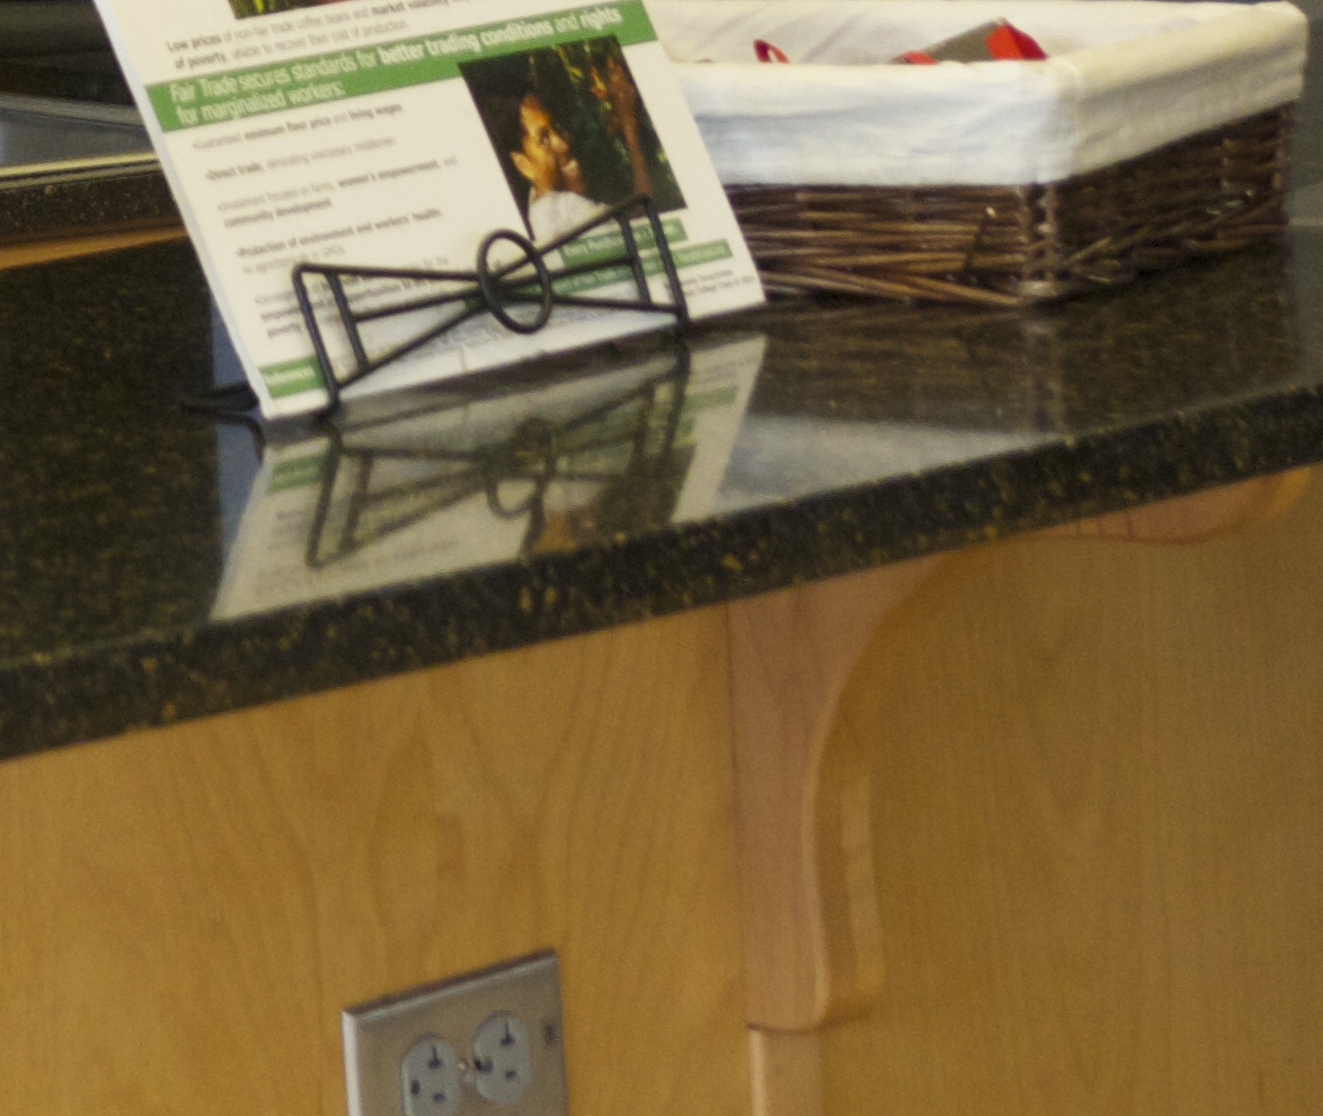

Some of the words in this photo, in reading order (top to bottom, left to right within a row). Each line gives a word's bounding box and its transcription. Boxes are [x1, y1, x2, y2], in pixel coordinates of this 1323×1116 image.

[167, 39, 188, 50] Low
[191, 35, 220, 48] prices
[371, 2, 404, 15] market
[169, 82, 197, 102] Fair
[199, 74, 239, 97] Trade
[238, 68, 290, 90] secures
[289, 53, 356, 80] standards
[355, 48, 378, 68] for
[377, 40, 426, 64] better
[424, 30, 481, 59] trading
[478, 17, 554, 46] conditions
[552, 13, 579, 33] and
[578, 5, 623, 32] rights
[175, 104, 199, 124] for
[197, 88, 287, 124] marginalized
